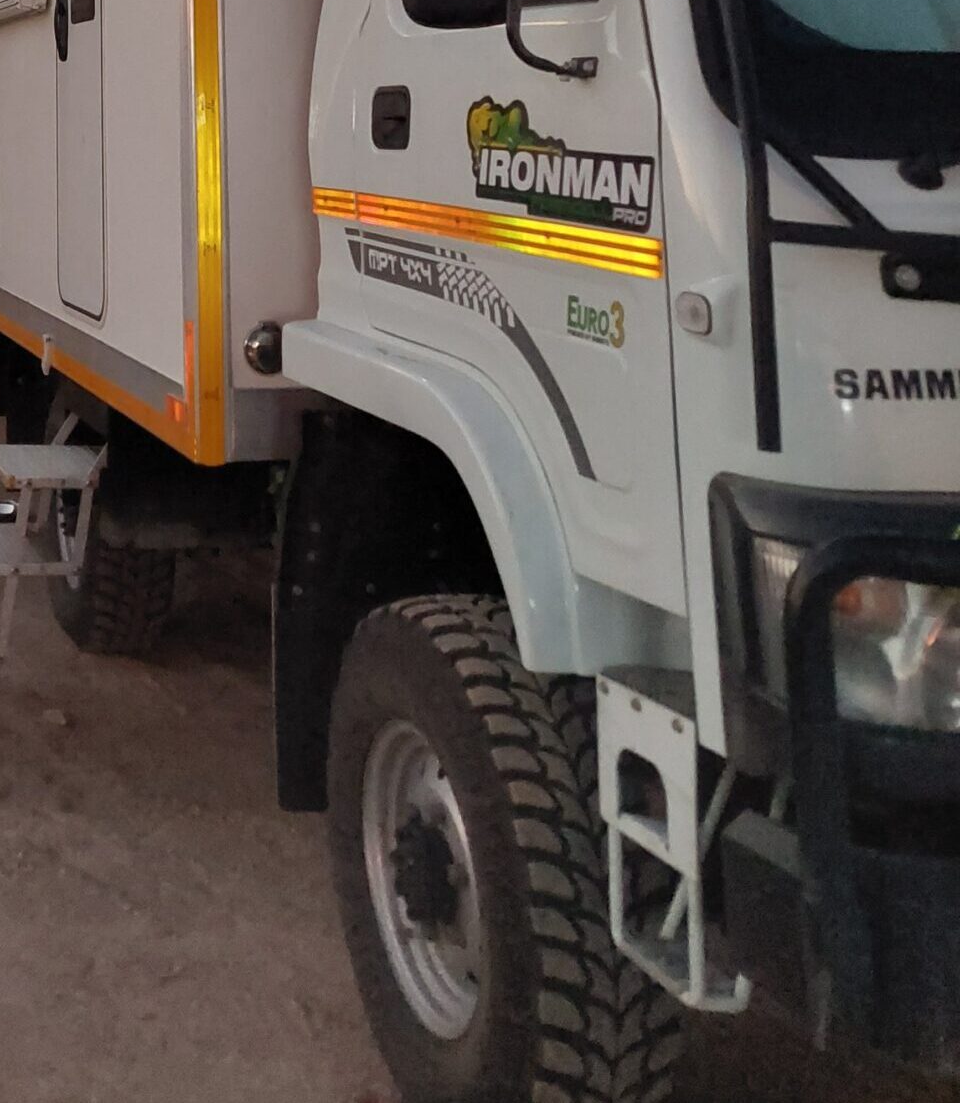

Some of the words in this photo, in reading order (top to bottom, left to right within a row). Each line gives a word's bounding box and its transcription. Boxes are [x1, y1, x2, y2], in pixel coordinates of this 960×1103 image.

[479, 148, 651, 207] IRONMAN
[612, 207, 647, 226] PRO
[834, 368, 960, 400] SAMM
